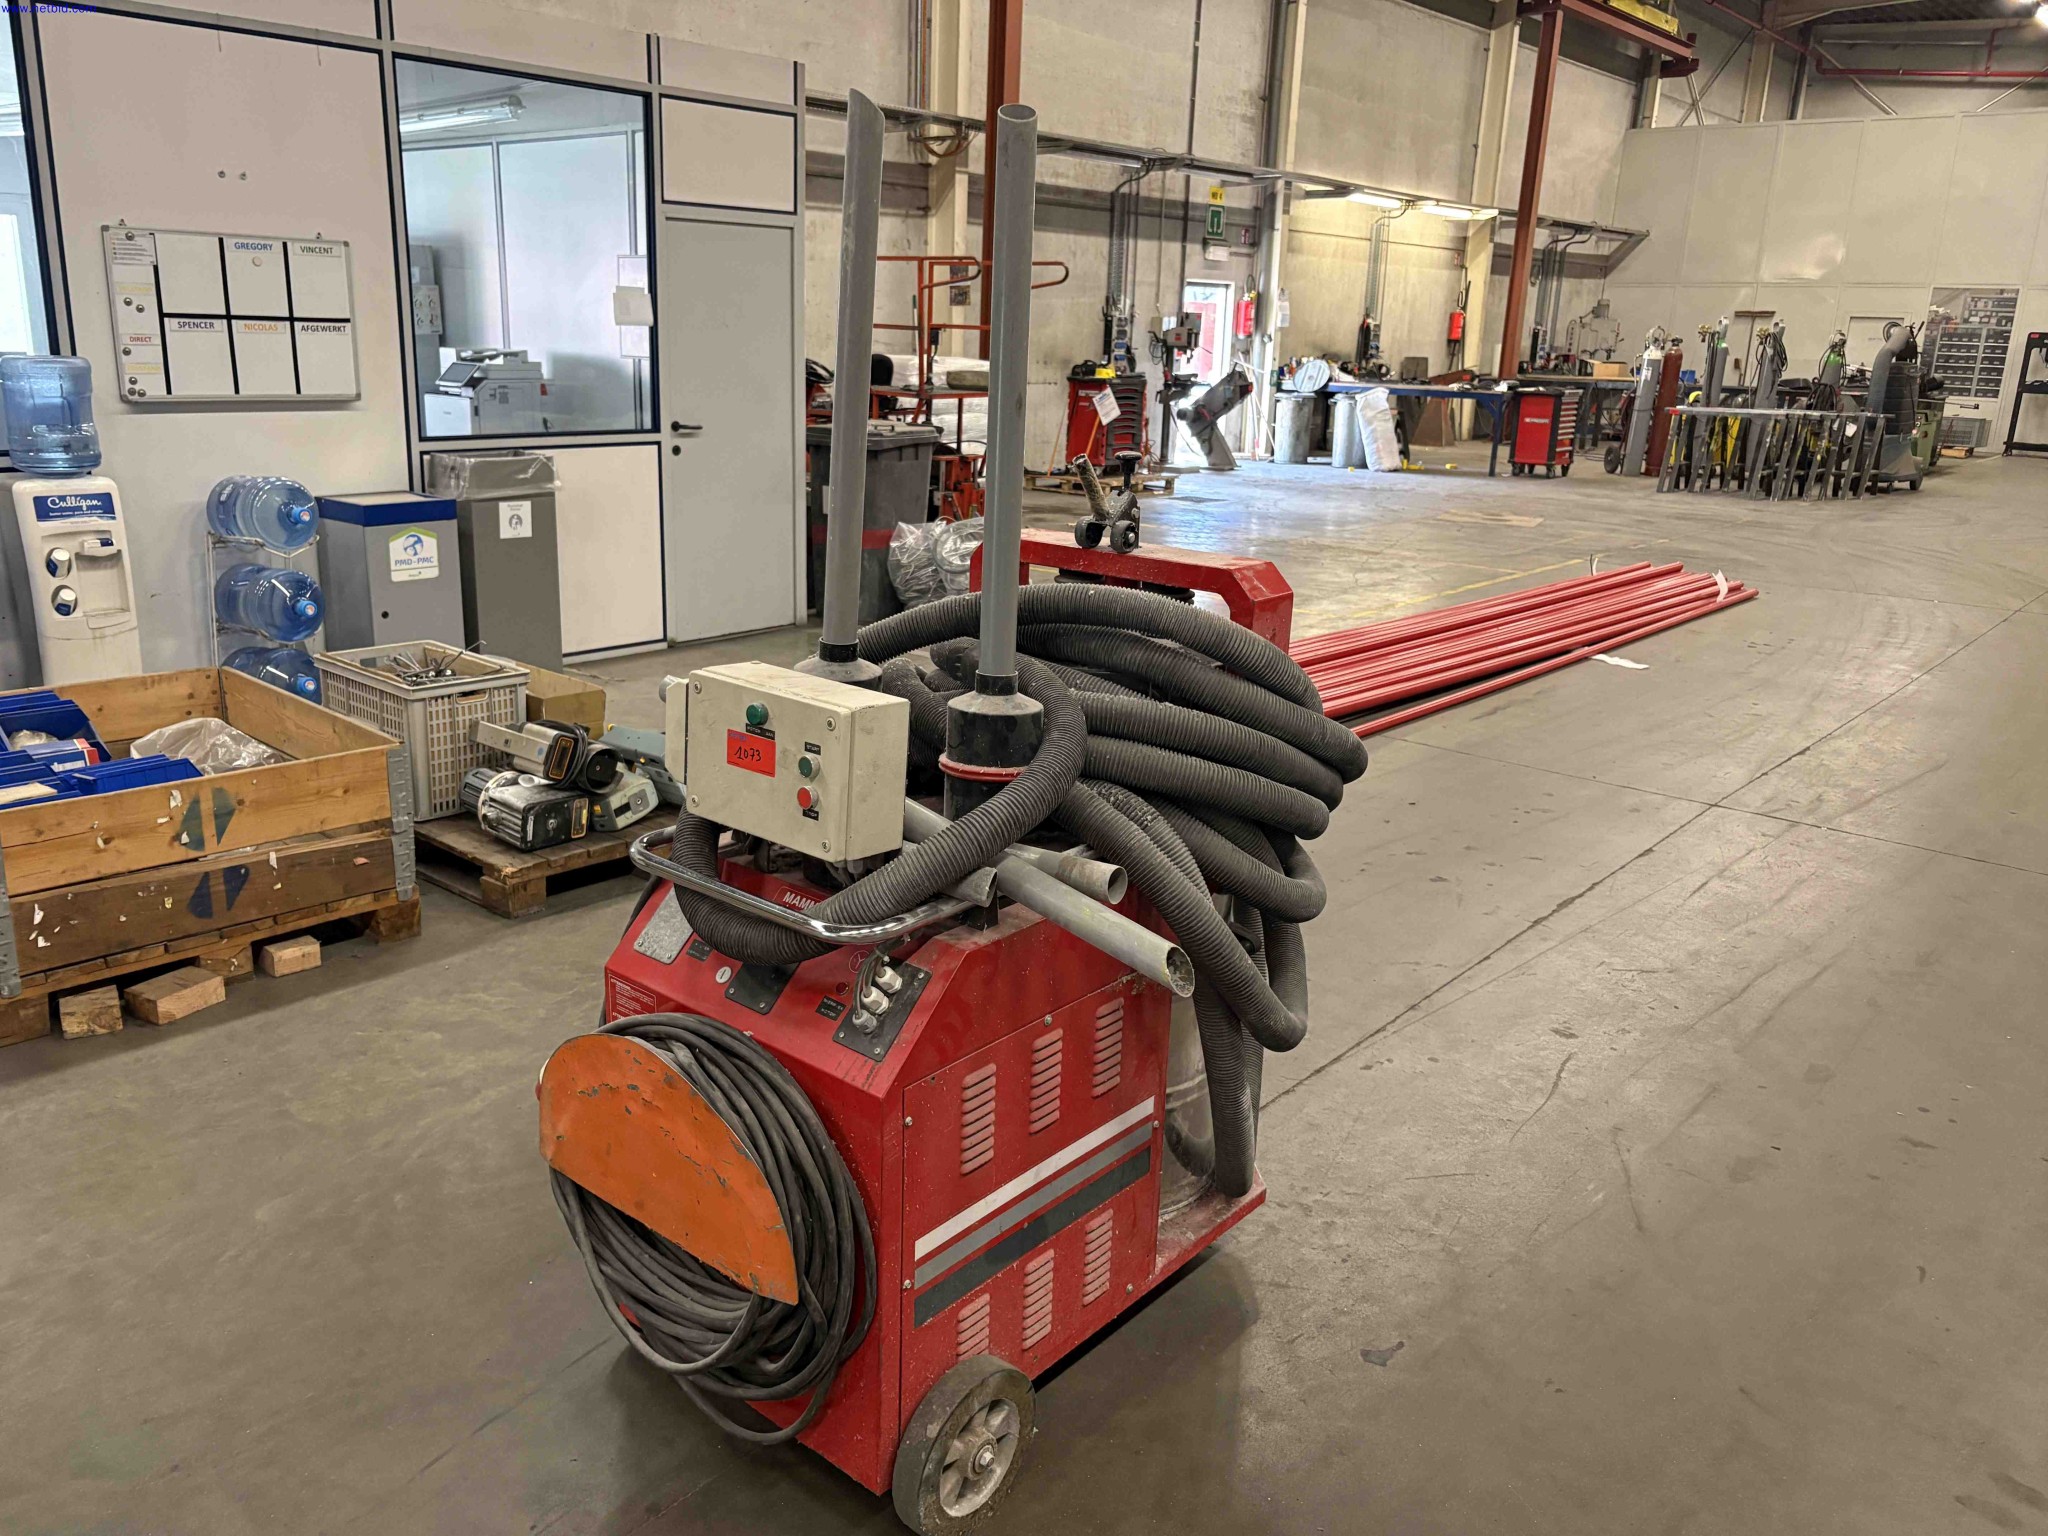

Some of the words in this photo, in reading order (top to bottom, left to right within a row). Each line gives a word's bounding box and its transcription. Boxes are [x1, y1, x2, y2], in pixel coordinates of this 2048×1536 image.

[234, 241, 273, 251] GREGORY
[300, 245, 334, 255] VINCENT
[177, 320, 215, 330] SPENCER
[244, 322, 278, 332] NICOLAS
[301, 324, 347, 334] AFGEWERKT
[129, 335, 152, 343] DIRECT
[47, 496, 102, 511] Culligan
[734, 745, 762, 762] 1073
